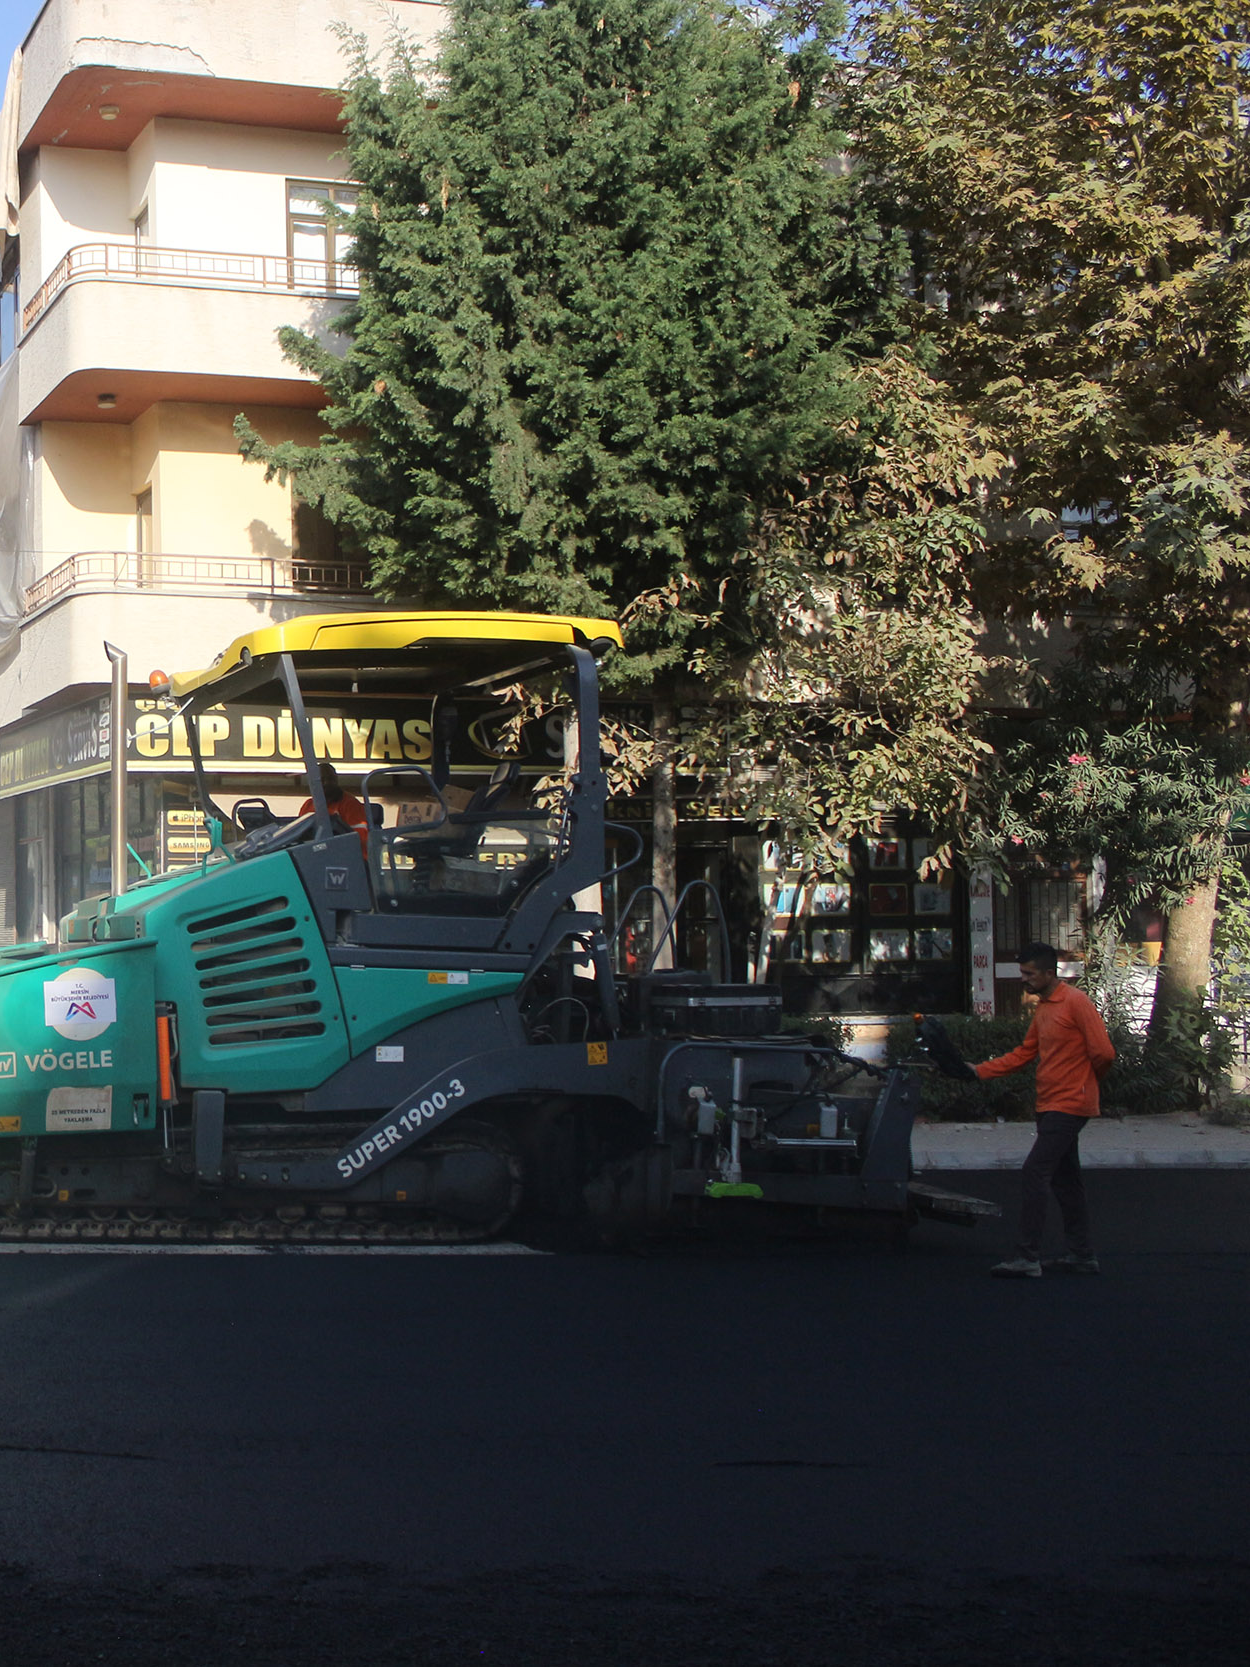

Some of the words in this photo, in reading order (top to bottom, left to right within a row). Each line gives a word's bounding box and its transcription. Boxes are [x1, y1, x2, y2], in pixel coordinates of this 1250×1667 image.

[242, 709, 433, 760] DÜNYAS
[181, 813, 204, 823] iPhon
[24, 1048, 113, 1072] VÖGELE
[337, 1124, 403, 1178] SUPER
[399, 1078, 466, 1135] 1900-3
